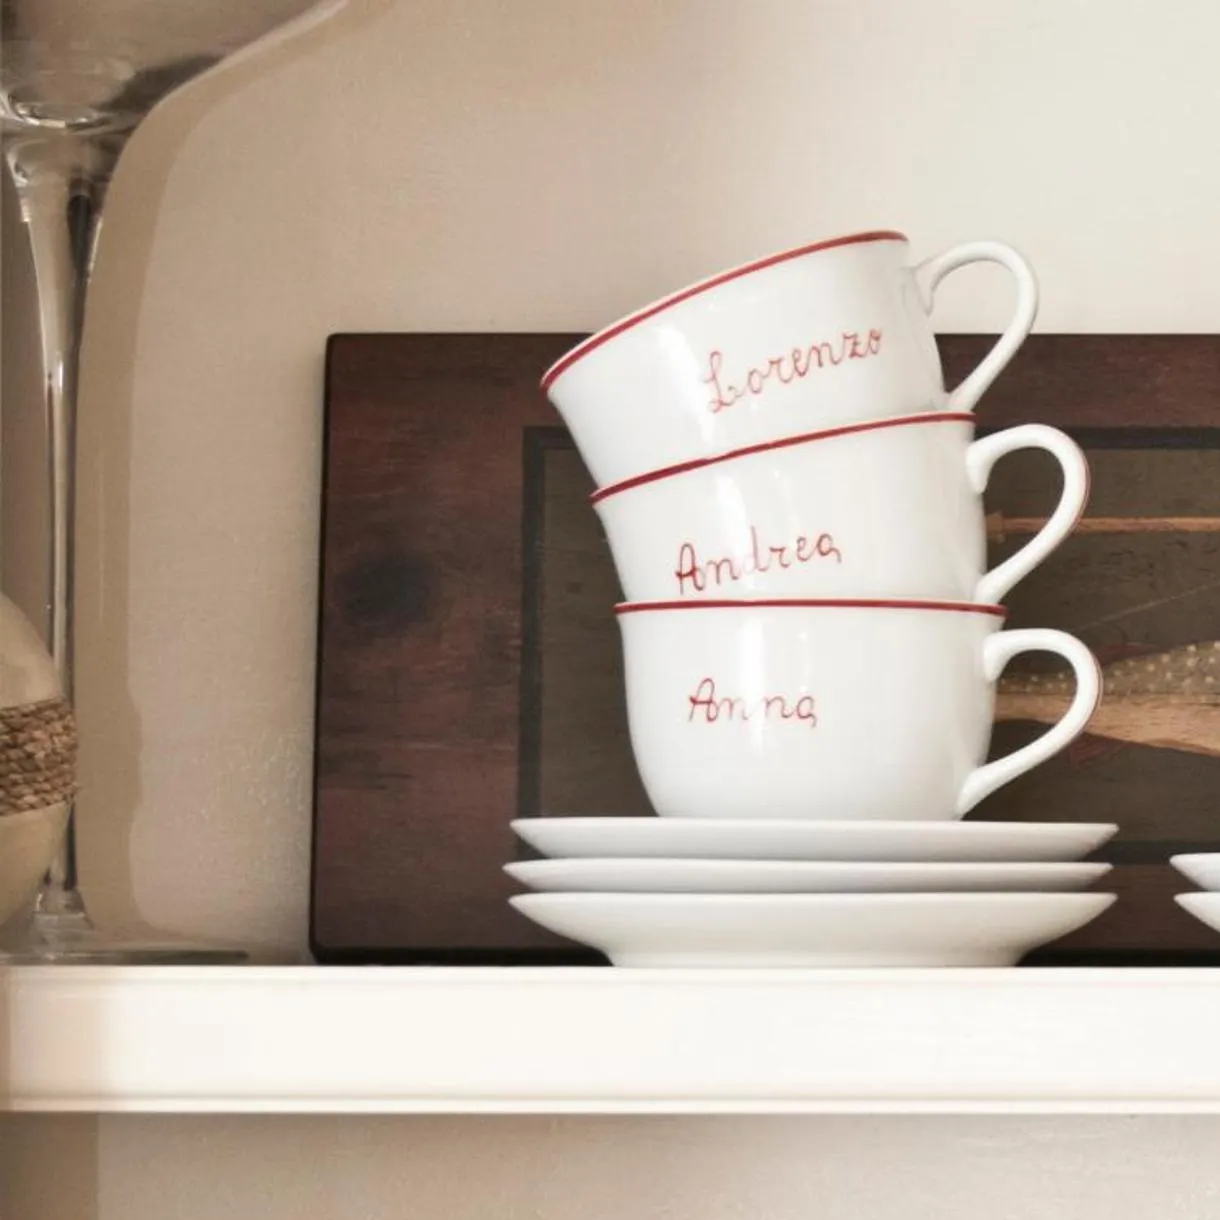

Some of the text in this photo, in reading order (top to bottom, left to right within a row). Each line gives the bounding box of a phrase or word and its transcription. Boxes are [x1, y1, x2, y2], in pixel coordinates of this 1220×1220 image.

[704, 327, 883, 414] Lorenzo
[674, 525, 842, 596] Andrea
[688, 677, 818, 728] Anna
